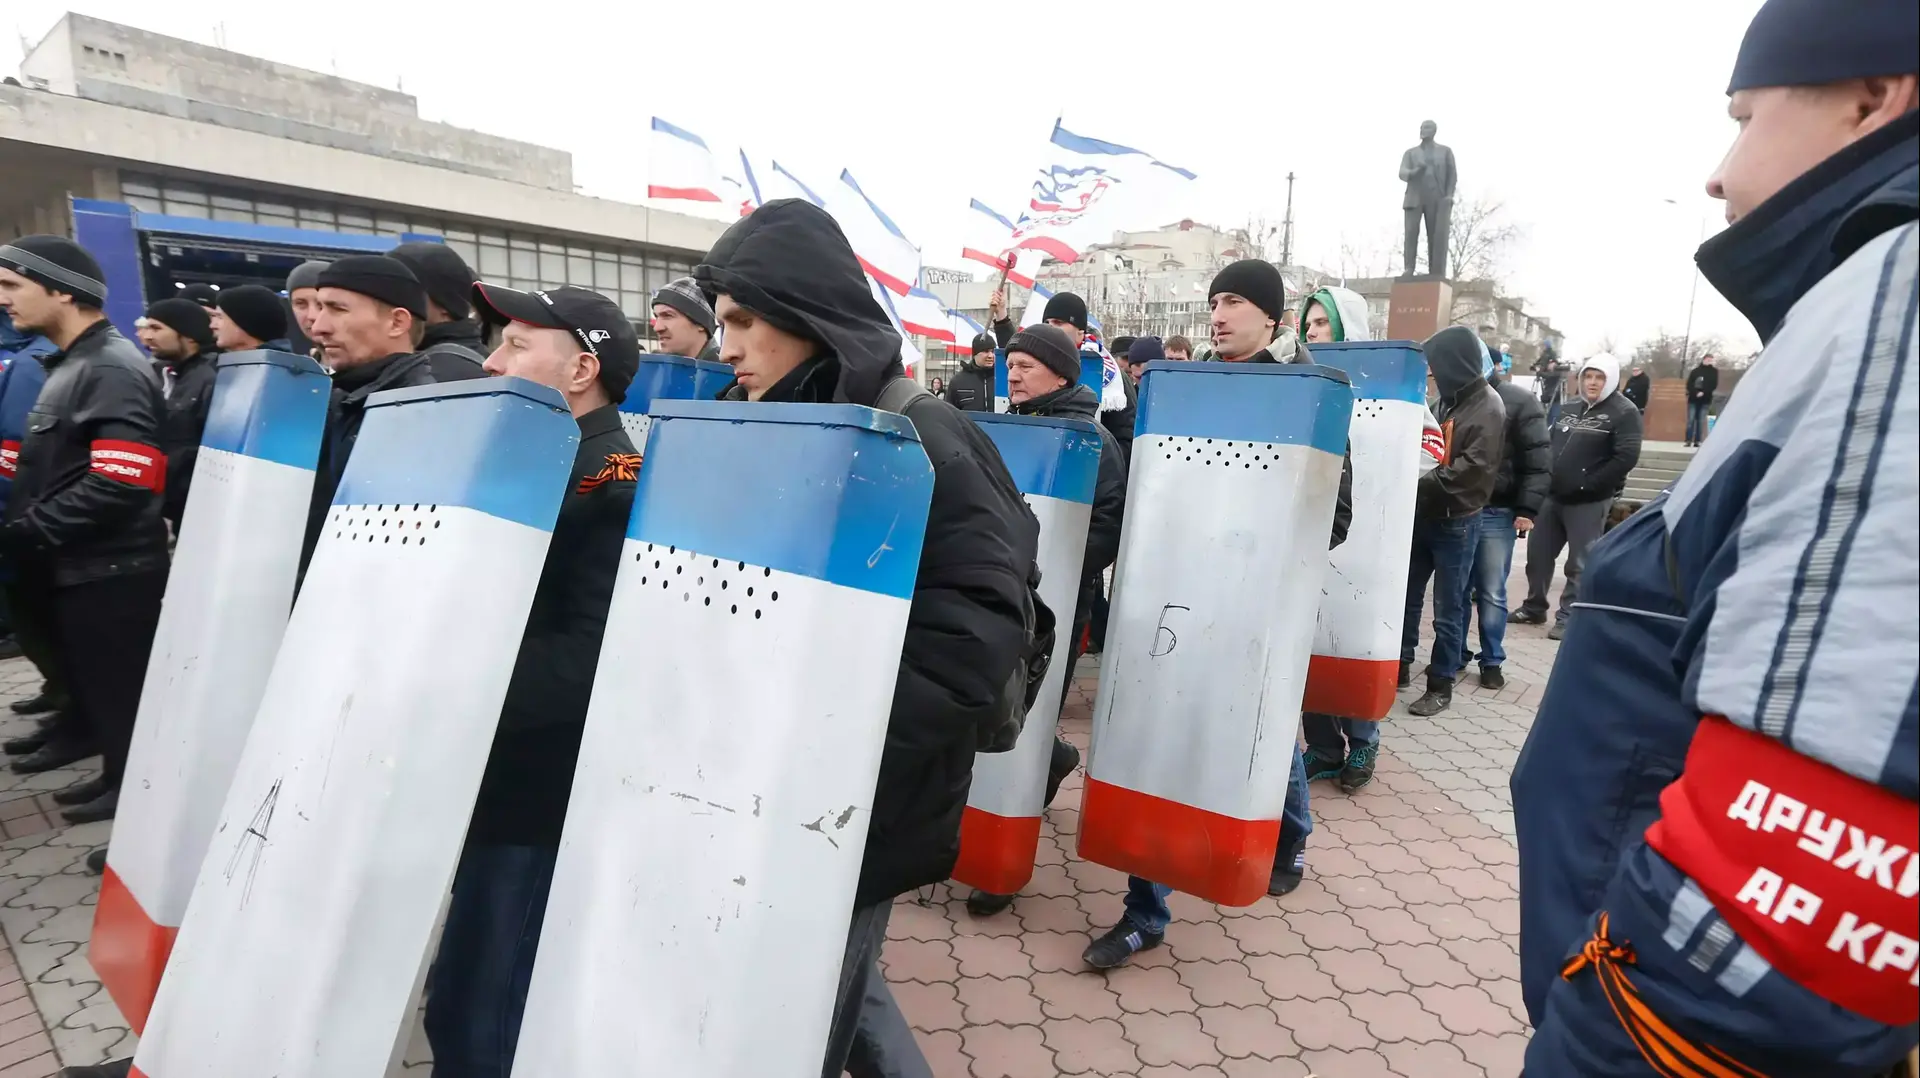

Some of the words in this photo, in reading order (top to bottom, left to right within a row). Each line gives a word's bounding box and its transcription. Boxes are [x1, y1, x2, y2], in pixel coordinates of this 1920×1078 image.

[576, 327, 599, 356] PETRONAS
[1149, 602, 1190, 660] Б
[1735, 866, 1824, 926] АР
[1825, 911, 1919, 987] КР
